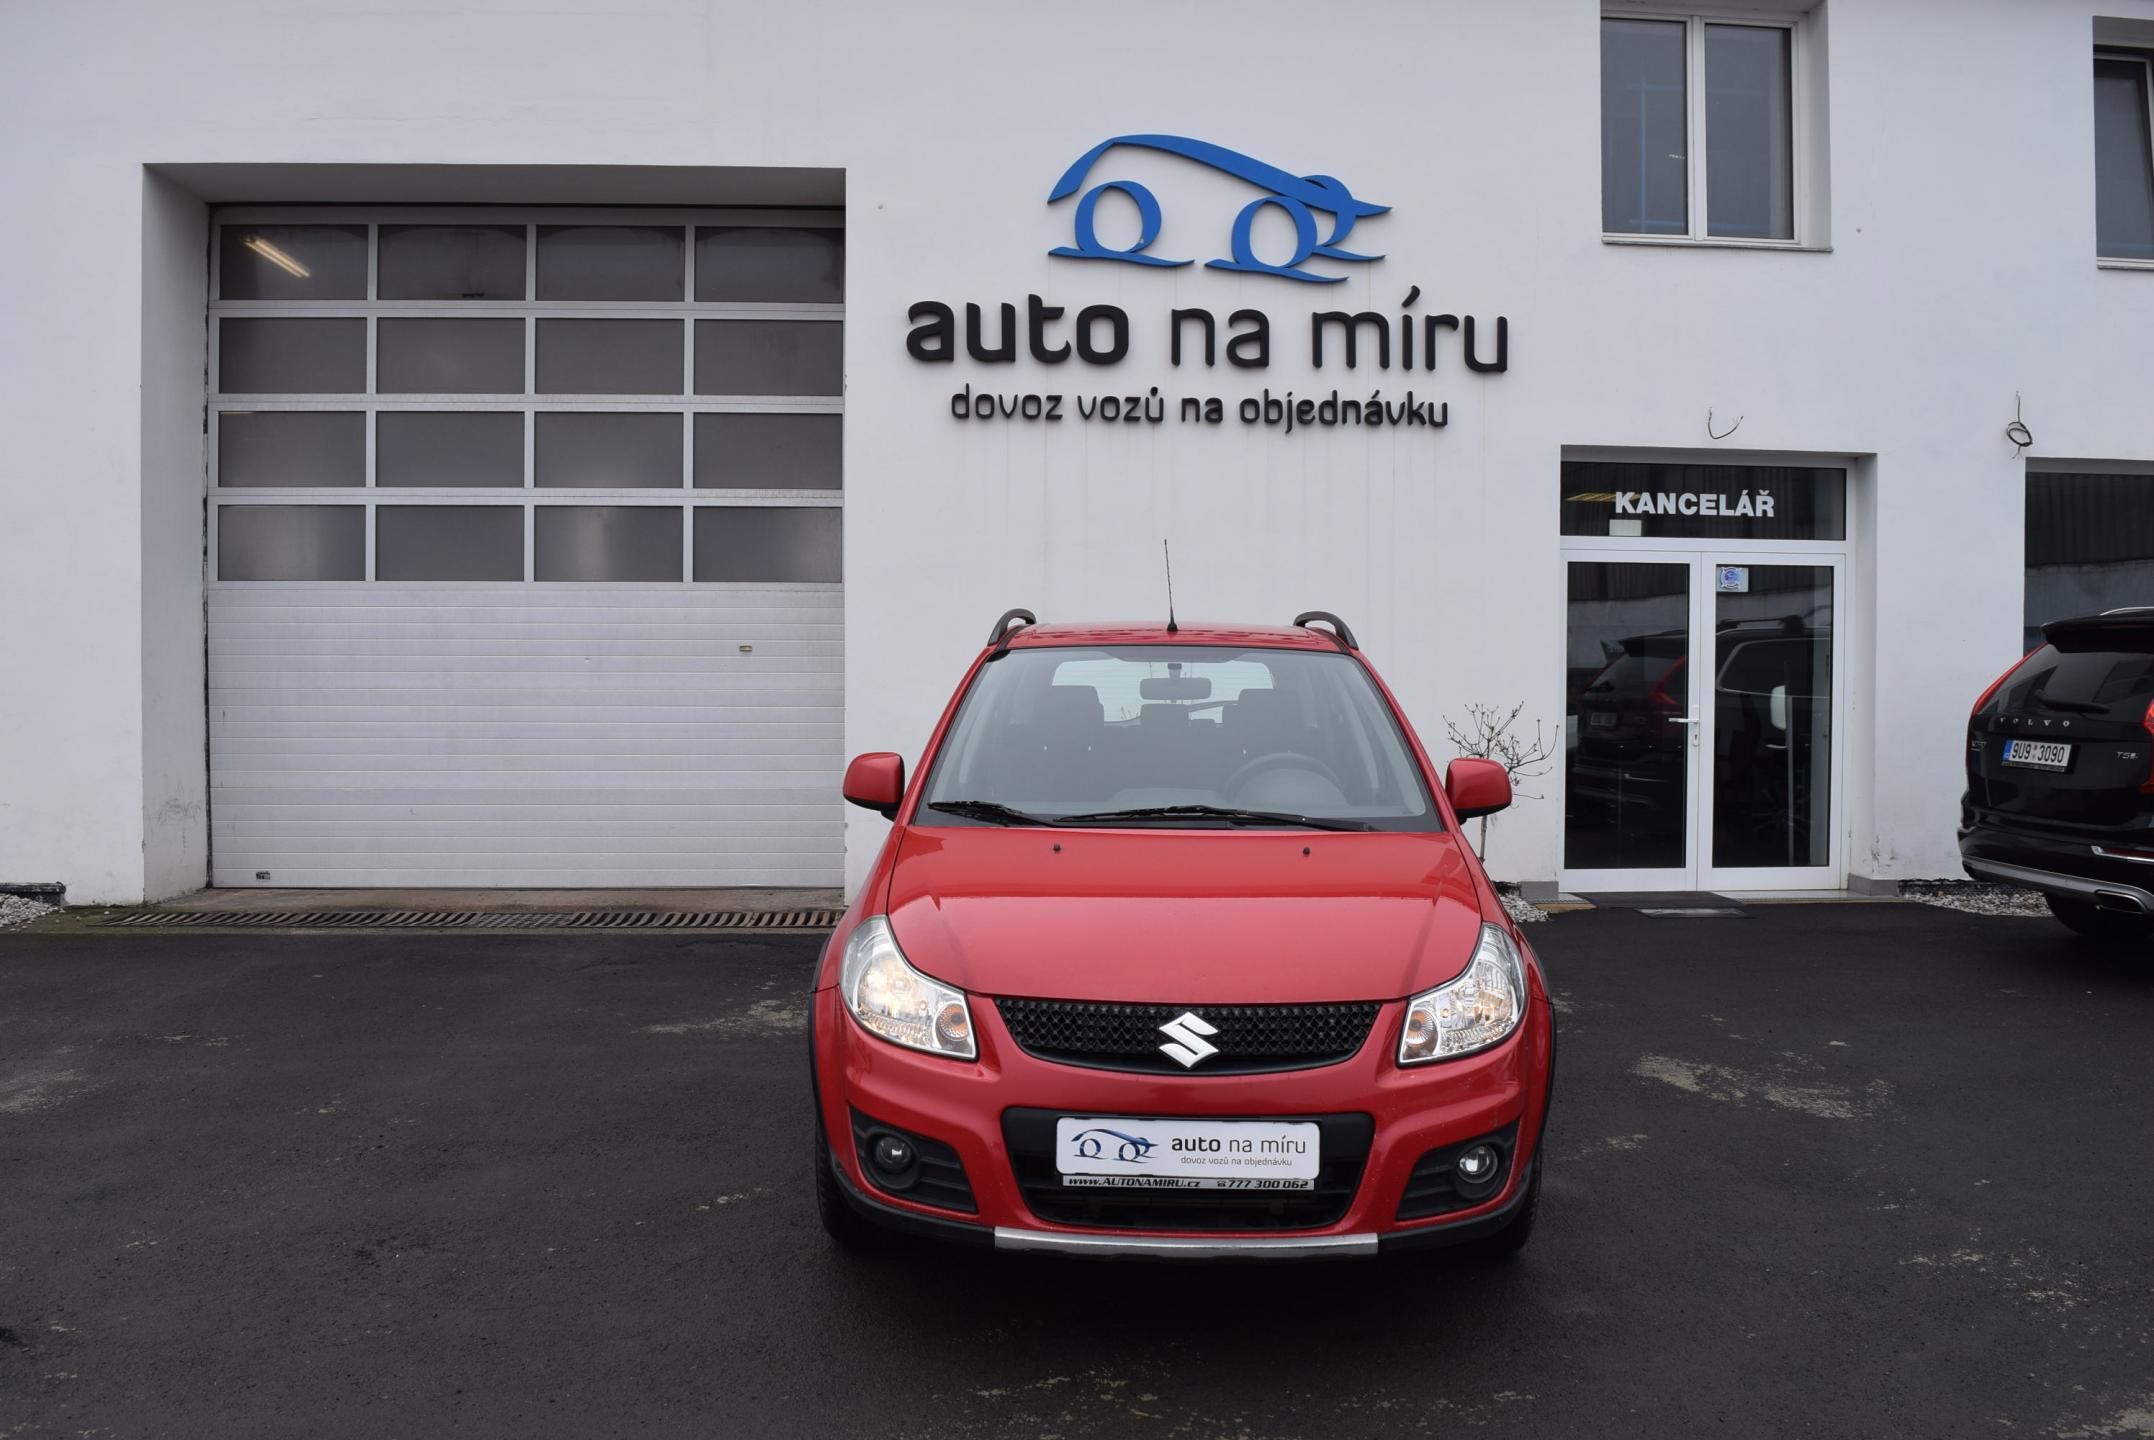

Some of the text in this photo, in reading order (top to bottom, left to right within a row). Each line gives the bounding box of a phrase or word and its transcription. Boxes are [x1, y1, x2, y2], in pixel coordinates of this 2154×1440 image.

[906, 285, 1508, 376] auto na míru
[951, 382, 1448, 435] dovoz vozů na objednávku
[1615, 489, 1775, 517] KANCELÁŘ
[1999, 716, 2071, 727] VOLVO
[2011, 741, 2032, 761] 9U9
[2037, 743, 2066, 764] 3090
[1171, 1135, 1306, 1154] auto na míru
[1180, 1155, 1293, 1167] dovoz vozů na objednávku
[1254, 1180, 1280, 1189] 300
[1282, 1180, 1309, 1189] 062
